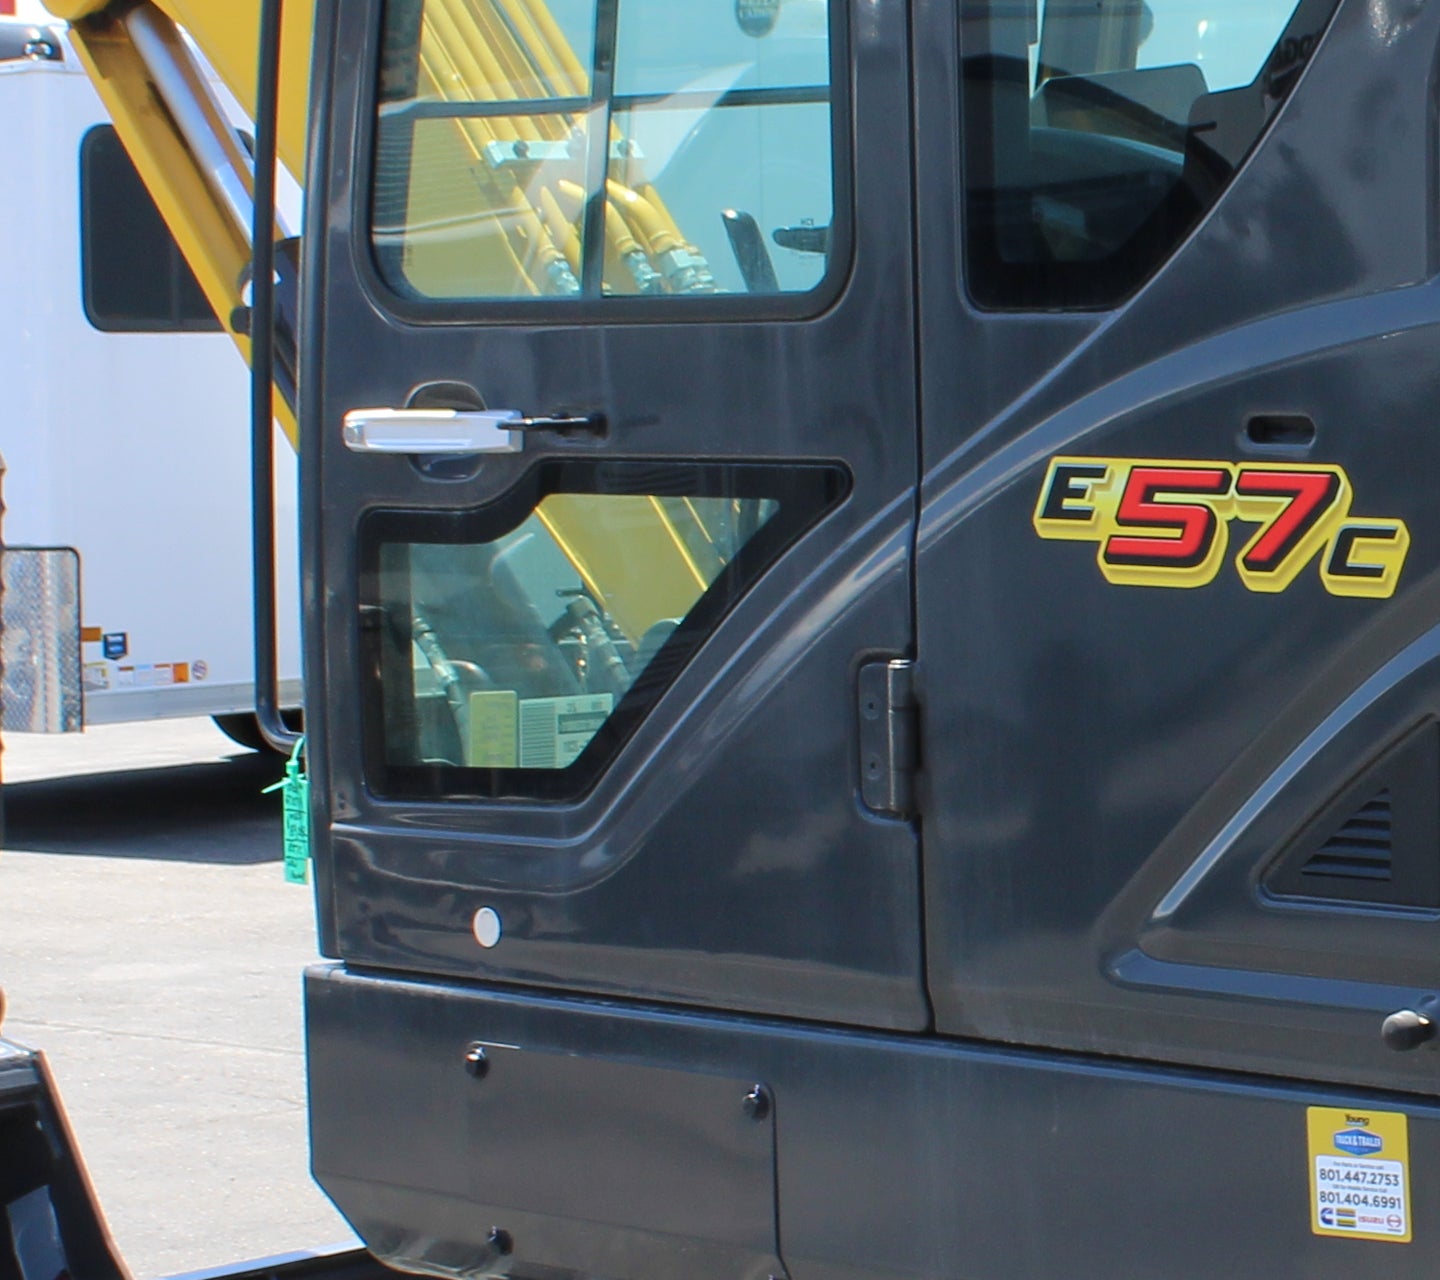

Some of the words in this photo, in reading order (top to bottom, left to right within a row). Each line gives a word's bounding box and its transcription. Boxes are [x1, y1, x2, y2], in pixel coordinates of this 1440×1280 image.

[1037, 458, 1406, 592] E57C
[1319, 1168, 1400, 1187] 801.447.2753
[1319, 1191, 1402, 1209] 801.404.6991
